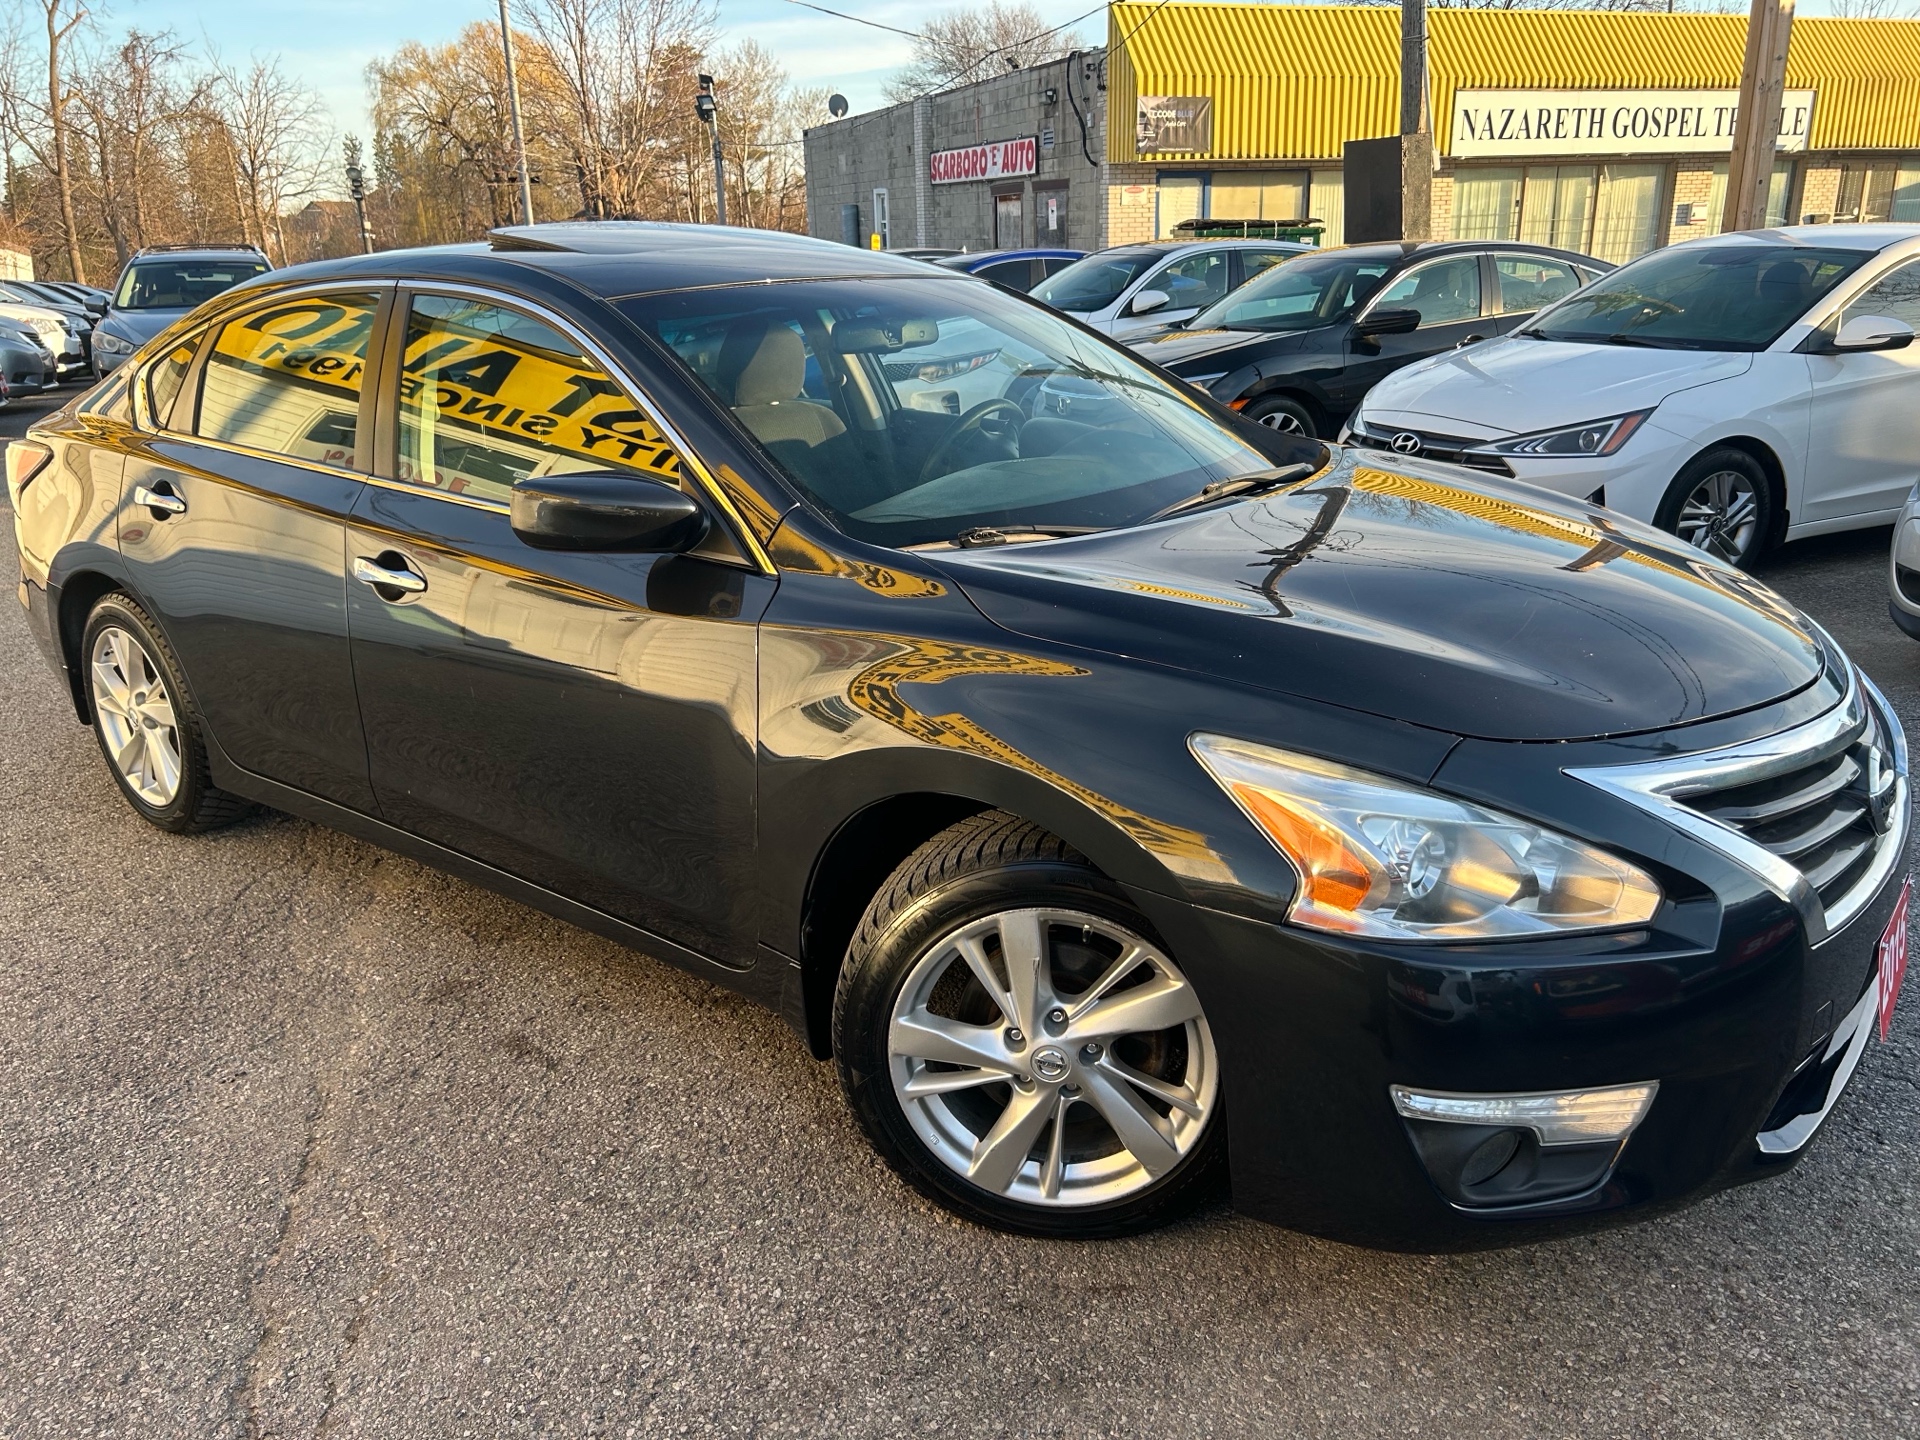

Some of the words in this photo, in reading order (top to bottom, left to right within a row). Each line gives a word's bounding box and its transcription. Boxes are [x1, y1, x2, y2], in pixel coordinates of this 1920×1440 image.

[1459, 107, 1607, 141] NAZARETH
[1611, 106, 1708, 139] GOSPEL
[931, 147, 988, 182] SCARBORO
[1001, 139, 1035, 174] AUTO
